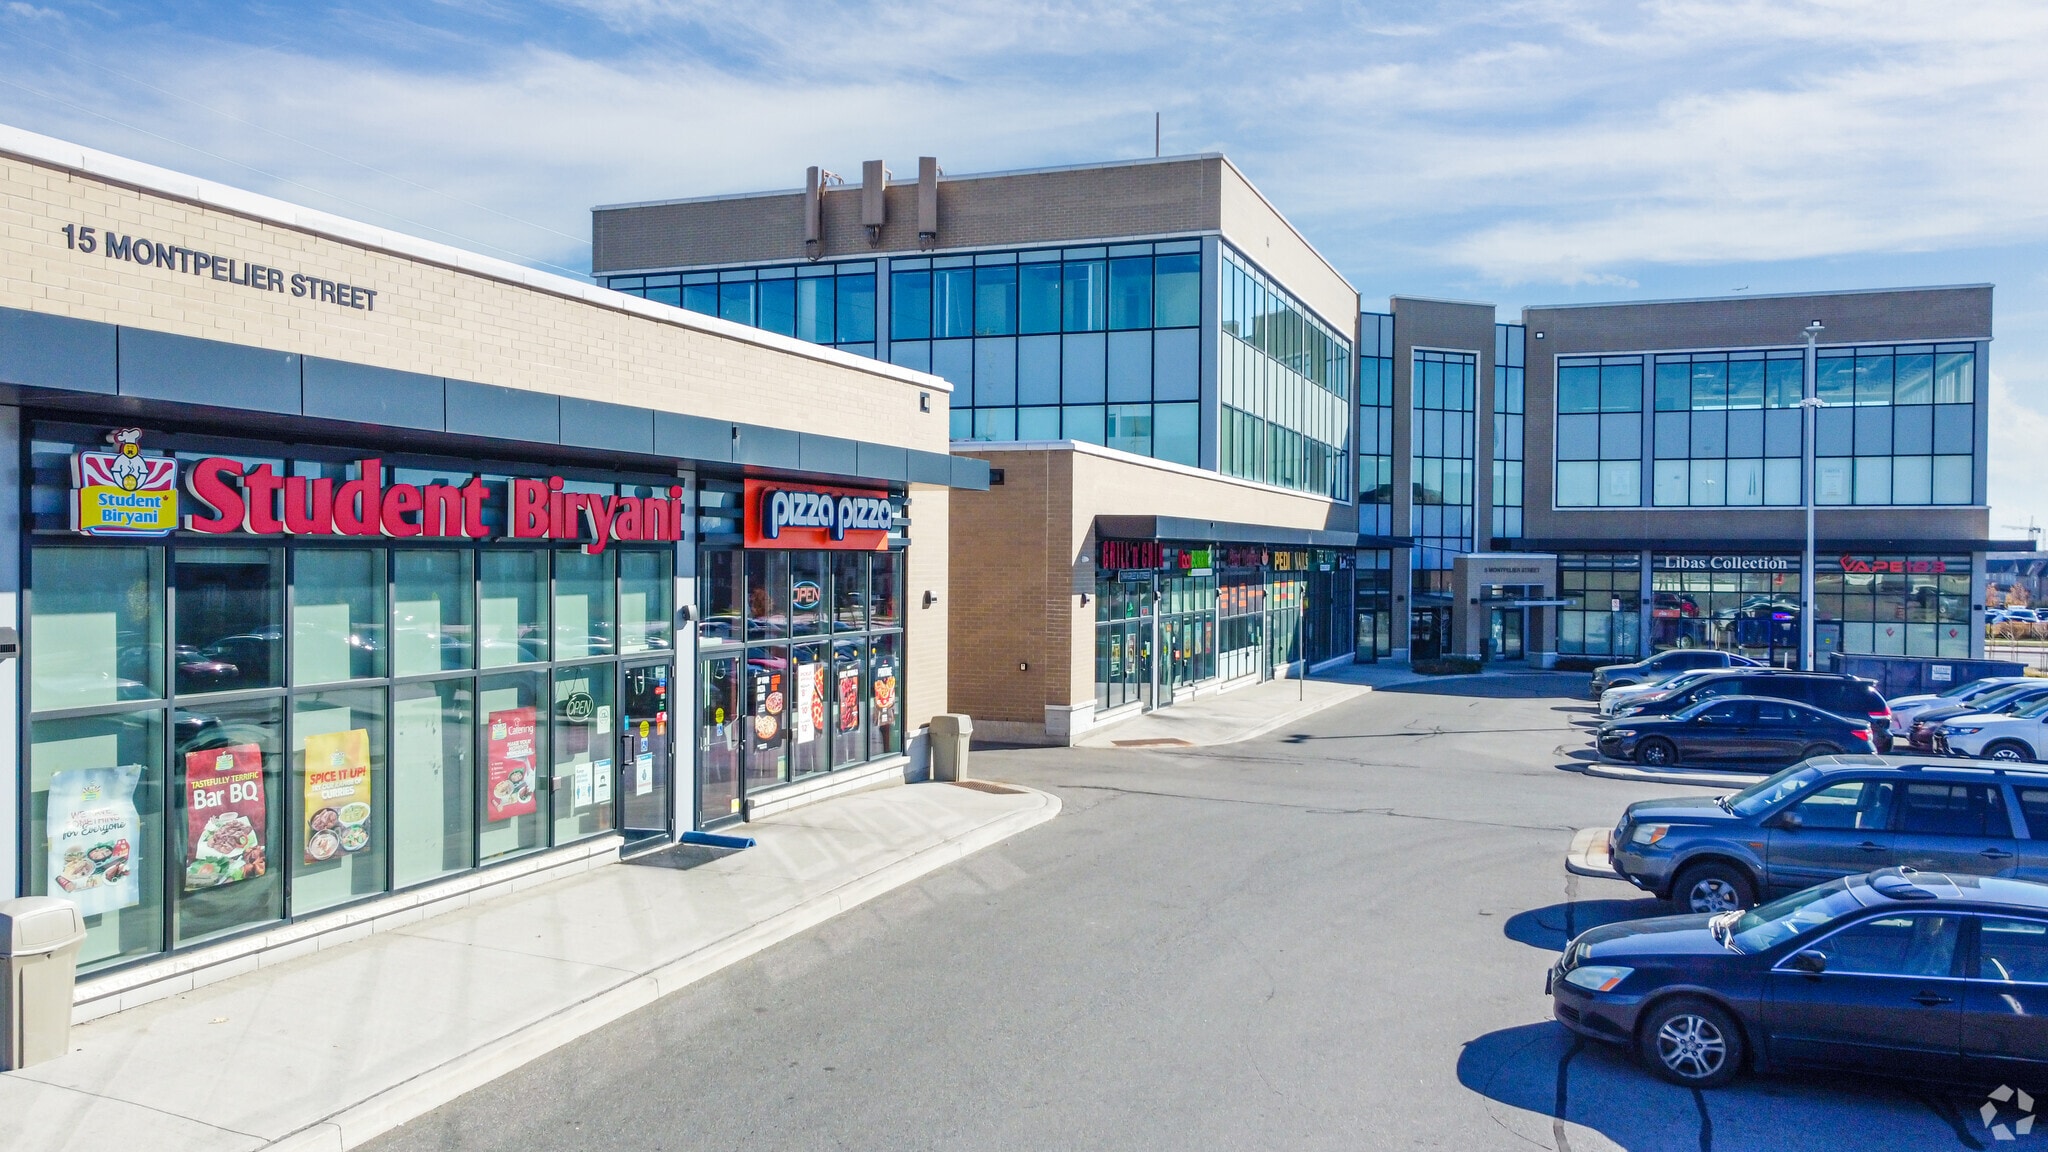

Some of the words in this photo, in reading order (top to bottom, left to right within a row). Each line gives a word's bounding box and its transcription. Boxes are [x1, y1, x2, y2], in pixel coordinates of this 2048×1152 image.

[62, 223, 97, 254] 15
[105, 232, 285, 294] MONTPELIER
[291, 273, 377, 312] STREET
[98, 493, 161, 509] Student
[185, 457, 490, 538] Student
[508, 475, 684, 555] Biryani
[102, 507, 158, 526] Biryani
[1664, 556, 1706, 569] Libas
[1710, 556, 1788, 570] Collection
[569, 699, 592, 716] OPEN
[191, 776, 230, 789] TASTEFULLY
[231, 771, 259, 782] TERRIFIC
[310, 771, 337, 785] SPICE
[338, 769, 347, 780] IT
[350, 765, 366, 778] UP!
[193, 789, 225, 810] Bar
[229, 780, 259, 803] BQ
[321, 786, 355, 800] CURRIES
[71, 810, 86, 819] WE
[81, 821, 127, 836] Everyone
